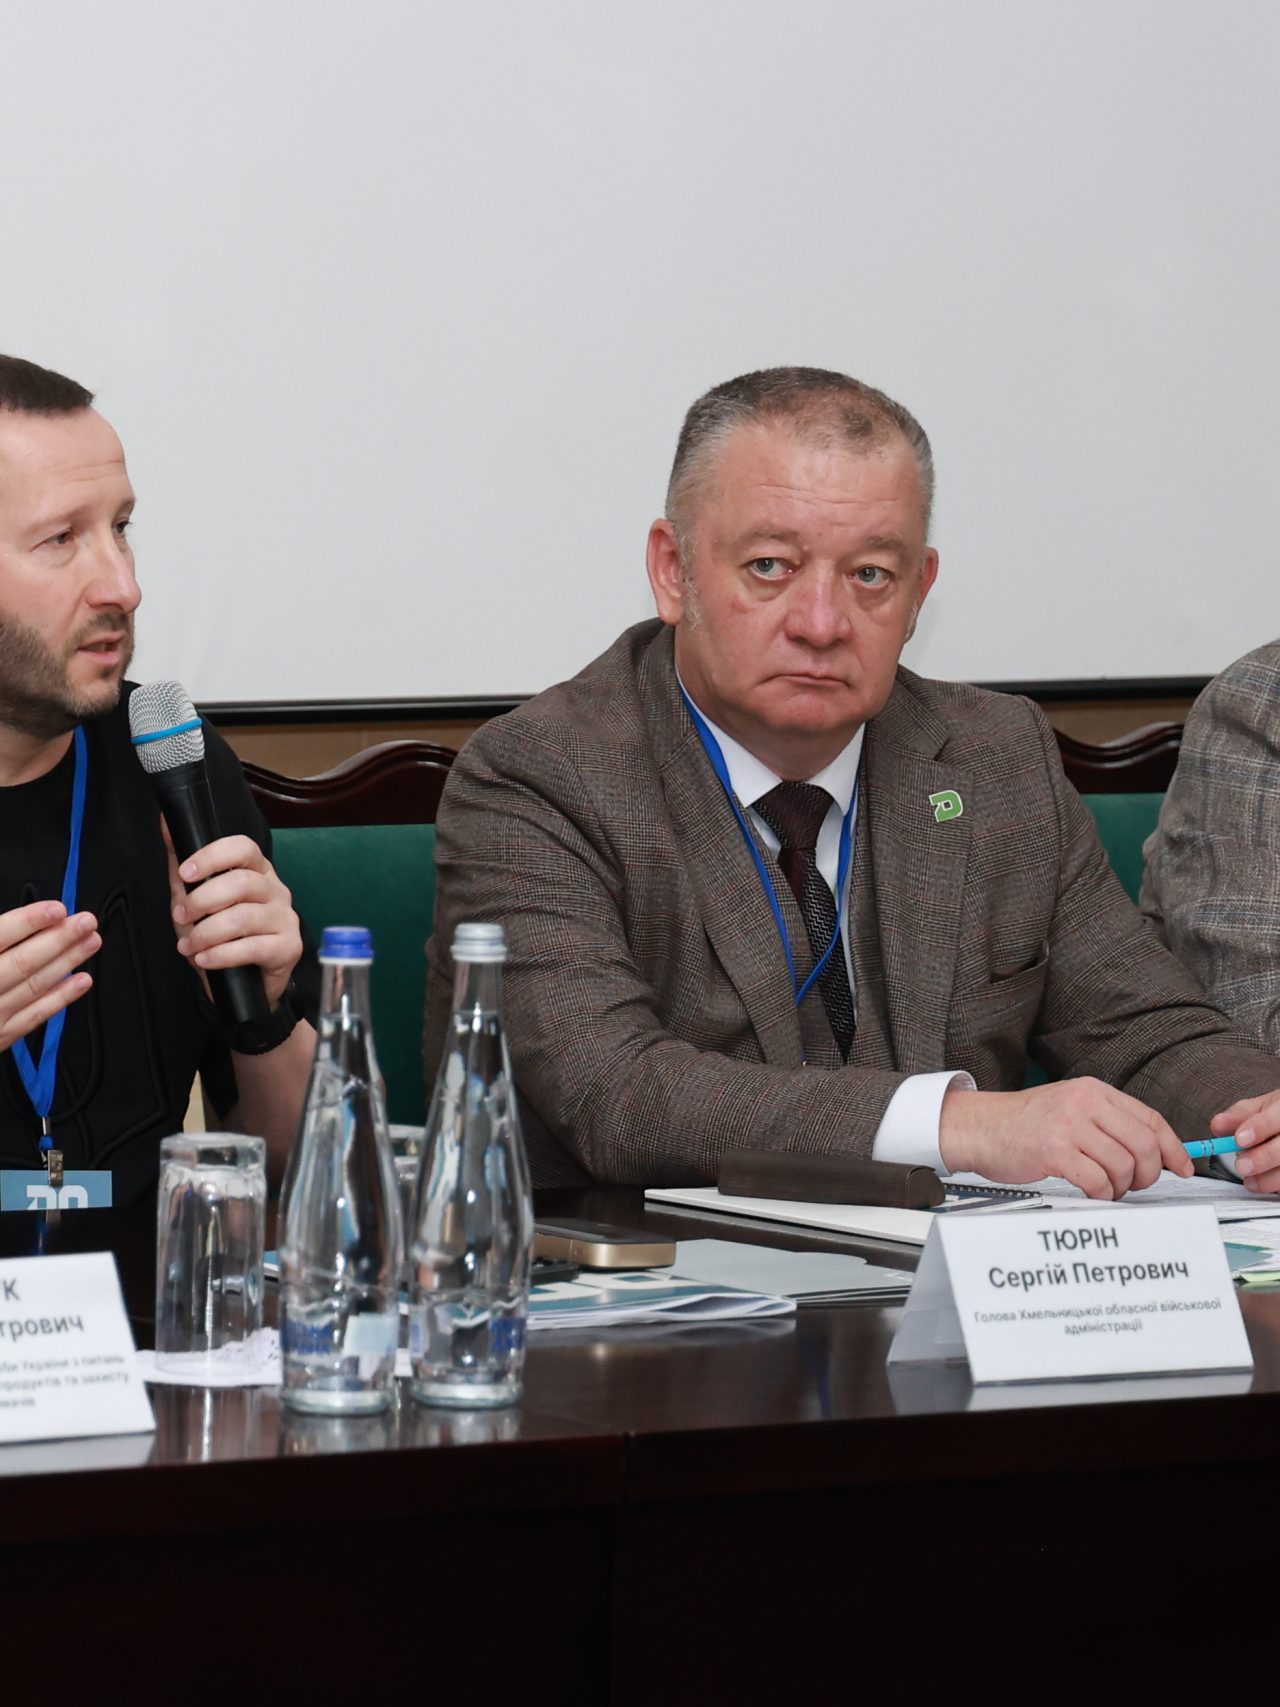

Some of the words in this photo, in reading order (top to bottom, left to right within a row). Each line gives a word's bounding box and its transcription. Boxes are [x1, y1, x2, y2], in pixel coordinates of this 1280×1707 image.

[1038, 1227, 1119, 1252] ТЮРІН
[989, 1263, 1068, 1292] Сергій
[1073, 1259, 1189, 1286] Петрович
[974, 1311, 1016, 1322] Голова
[1019, 1303, 1103, 1320] Хмельницької
[1105, 1301, 1157, 1315] обласної
[1160, 1297, 1222, 1311] військової
[1065, 1319, 1142, 1335] адміністрації
